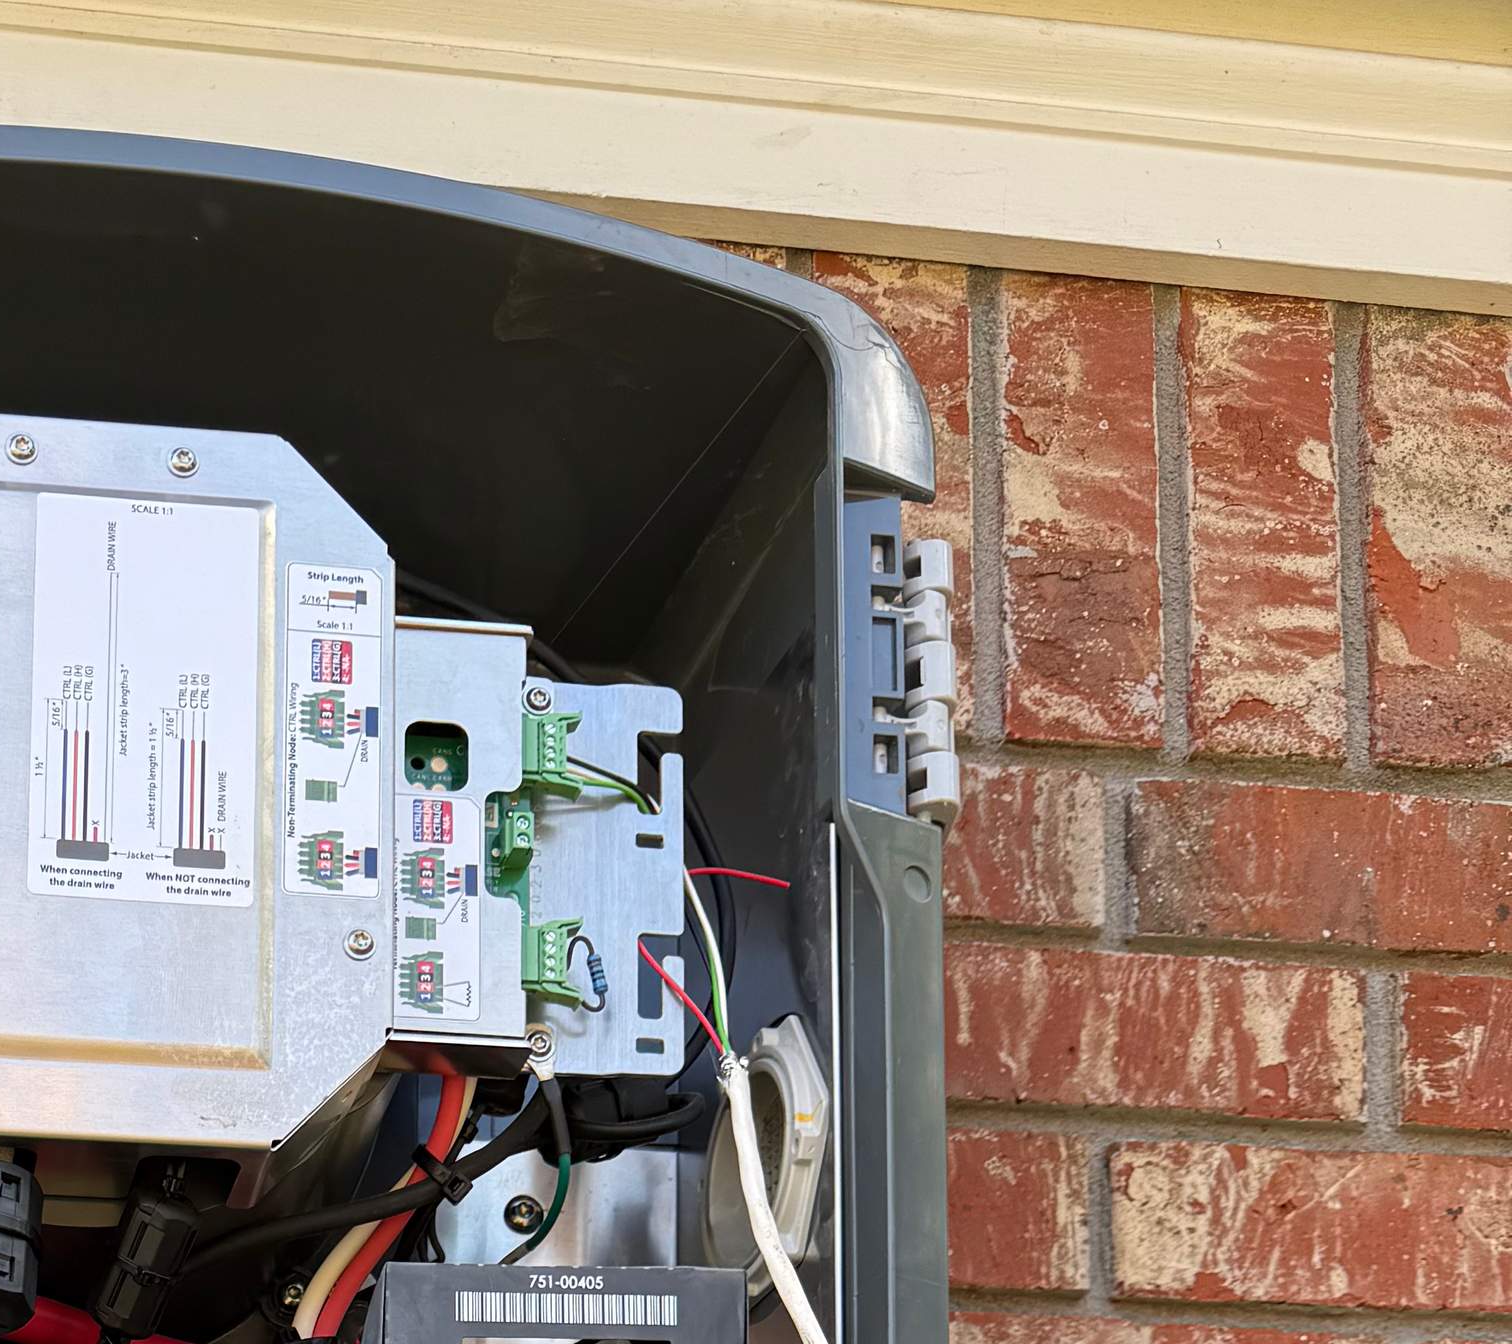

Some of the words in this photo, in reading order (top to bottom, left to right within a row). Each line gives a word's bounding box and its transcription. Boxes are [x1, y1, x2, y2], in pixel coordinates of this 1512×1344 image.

[132, 505, 159, 514] SCALE
[162, 507, 173, 515] 1:1
[108, 521, 116, 542] WIRE
[107, 544, 116, 571] DRAIN
[307, 572, 329, 583] Strip
[332, 574, 364, 585] Length
[317, 620, 339, 630] Scale
[63, 678, 72, 700] CTRL
[73, 679, 82, 700] CTRL
[84, 680, 93, 701] CTRL
[179, 685, 187, 709] CTRL
[190, 685, 198, 709] CTRL
[201, 687, 209, 710] CTRL
[120, 710, 129, 730] strip
[119, 734, 128, 756] Jacket
[288, 733, 298, 770] Node:
[360, 739, 368, 762] DRAIN
[149, 752, 158, 785] length
[219, 770, 227, 793] WIRE
[148, 788, 156, 806] strip
[288, 773, 298, 838] Non-Terminating
[218, 794, 226, 822] DRAIN
[147, 808, 155, 830] Jacket
[126, 851, 154, 861] Jacket
[40, 864, 67, 875] When
[69, 868, 123, 880] connecting
[146, 872, 173, 882] When
[175, 874, 195, 884] NOT
[197, 876, 251, 887] connecting
[49, 878, 65, 886] the
[67, 879, 92, 889] drain
[94, 881, 115, 890] wire
[166, 886, 182, 894] the
[184, 887, 209, 896] drain
[211, 889, 231, 897] wire
[461, 899, 469, 924] DRAIN
[529, 1274, 604, 1291] 751-00405
